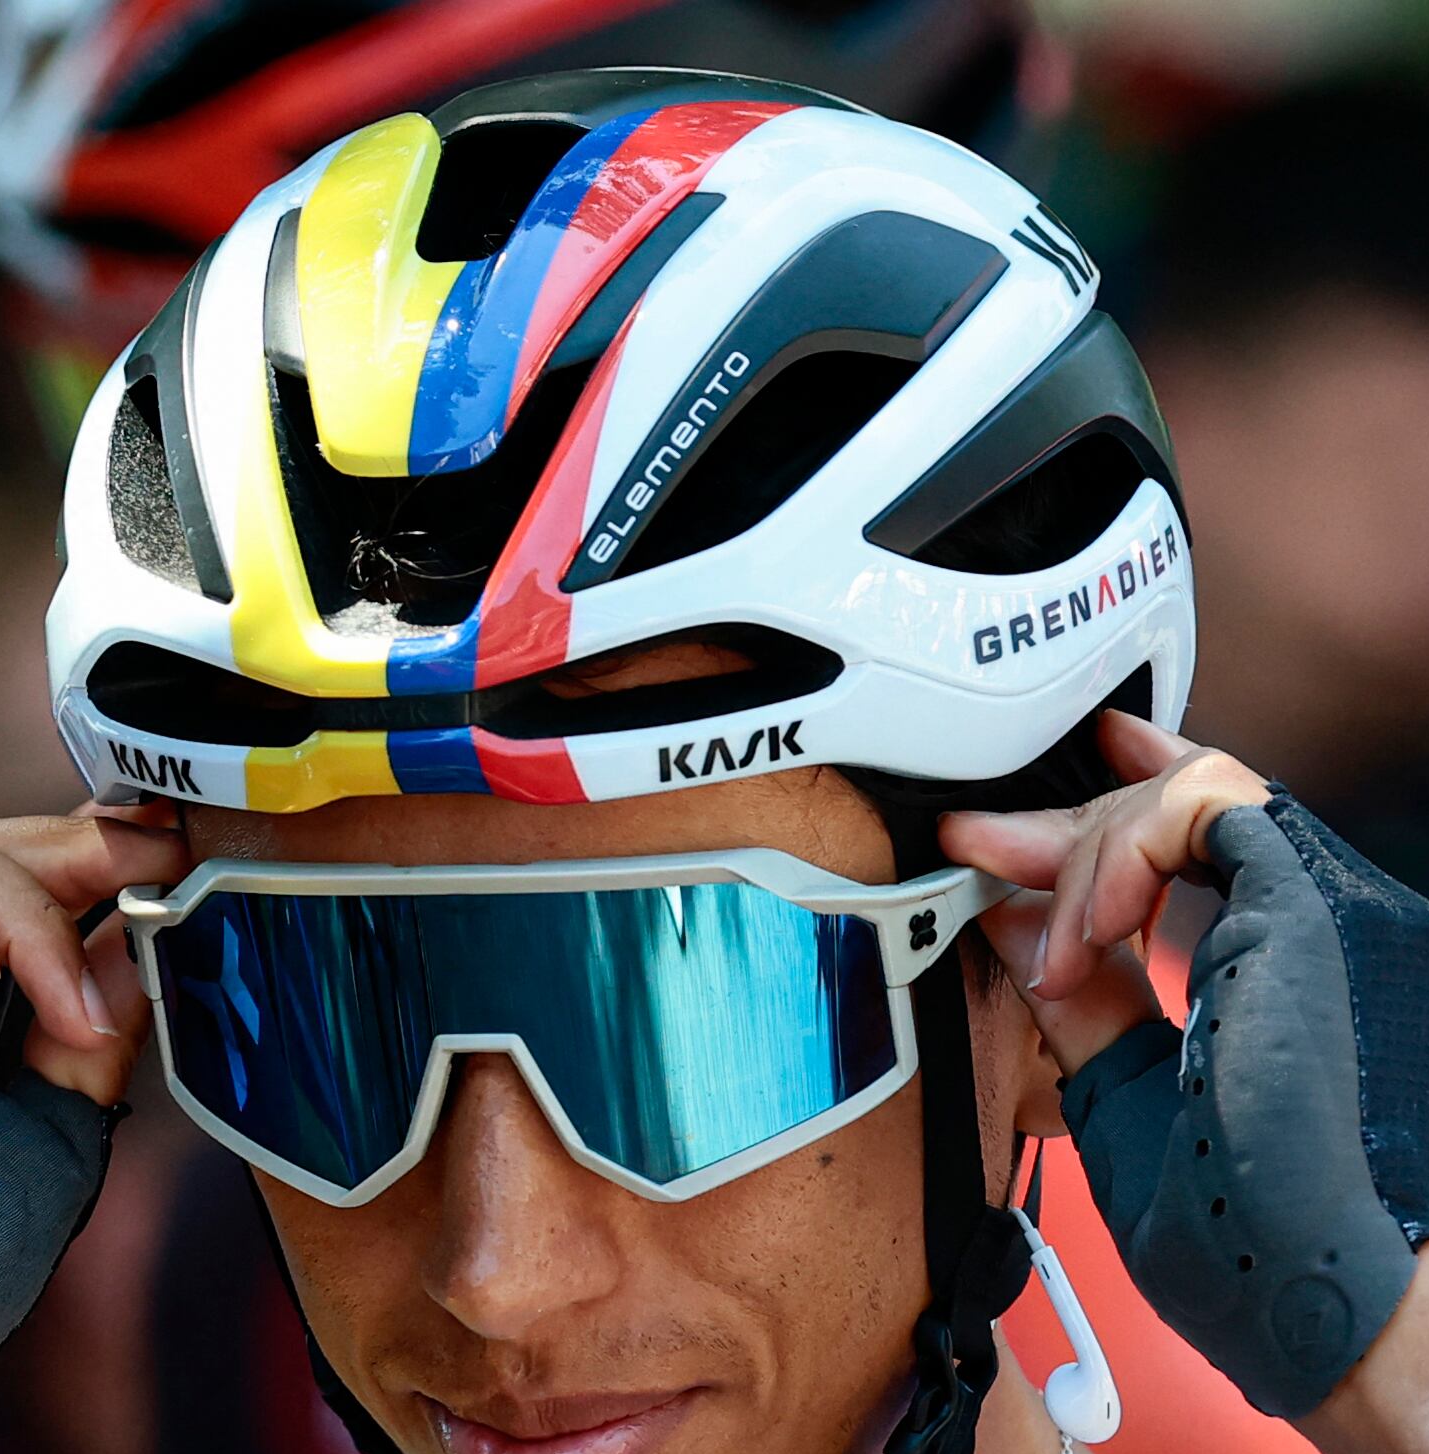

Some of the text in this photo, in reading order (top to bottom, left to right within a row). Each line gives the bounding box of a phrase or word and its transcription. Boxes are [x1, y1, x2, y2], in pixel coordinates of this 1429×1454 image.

[973, 525, 1178, 665] GRENADIER
[107, 739, 203, 796] KASK
[658, 720, 805, 783] KASK
